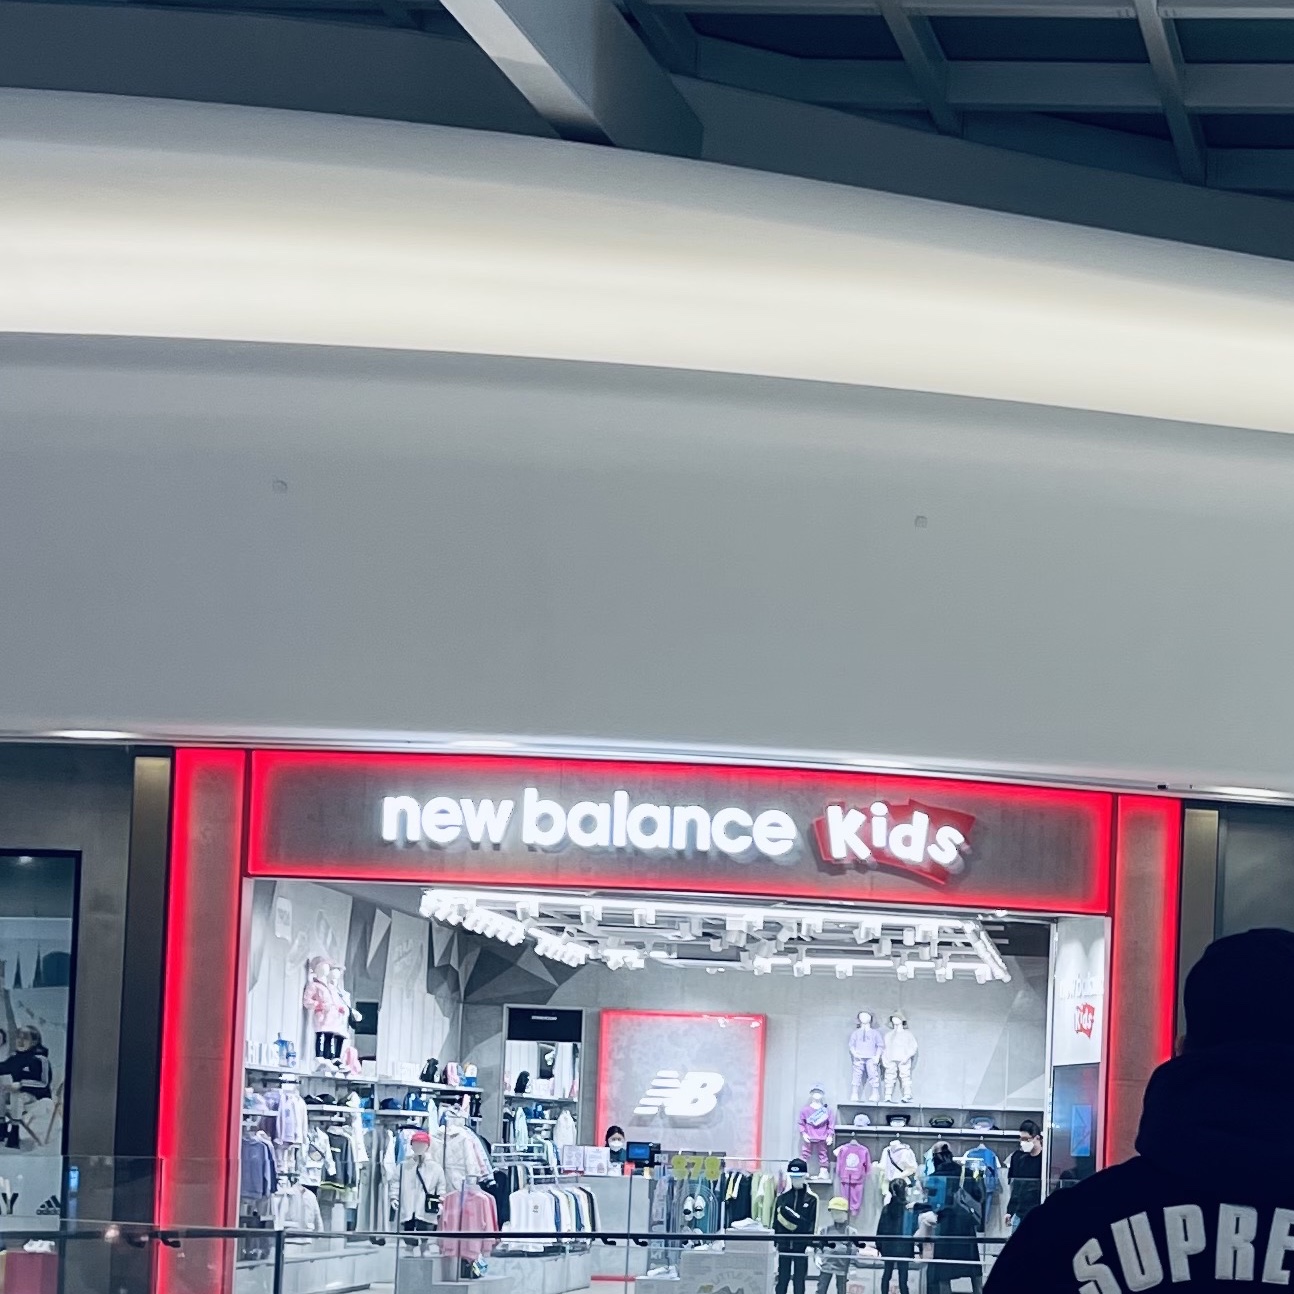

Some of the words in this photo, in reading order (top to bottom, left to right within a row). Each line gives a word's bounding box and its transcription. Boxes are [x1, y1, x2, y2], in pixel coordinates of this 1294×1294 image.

[381, 793, 514, 846] new
[521, 787, 798, 857] balance
[825, 801, 967, 866] Kids
